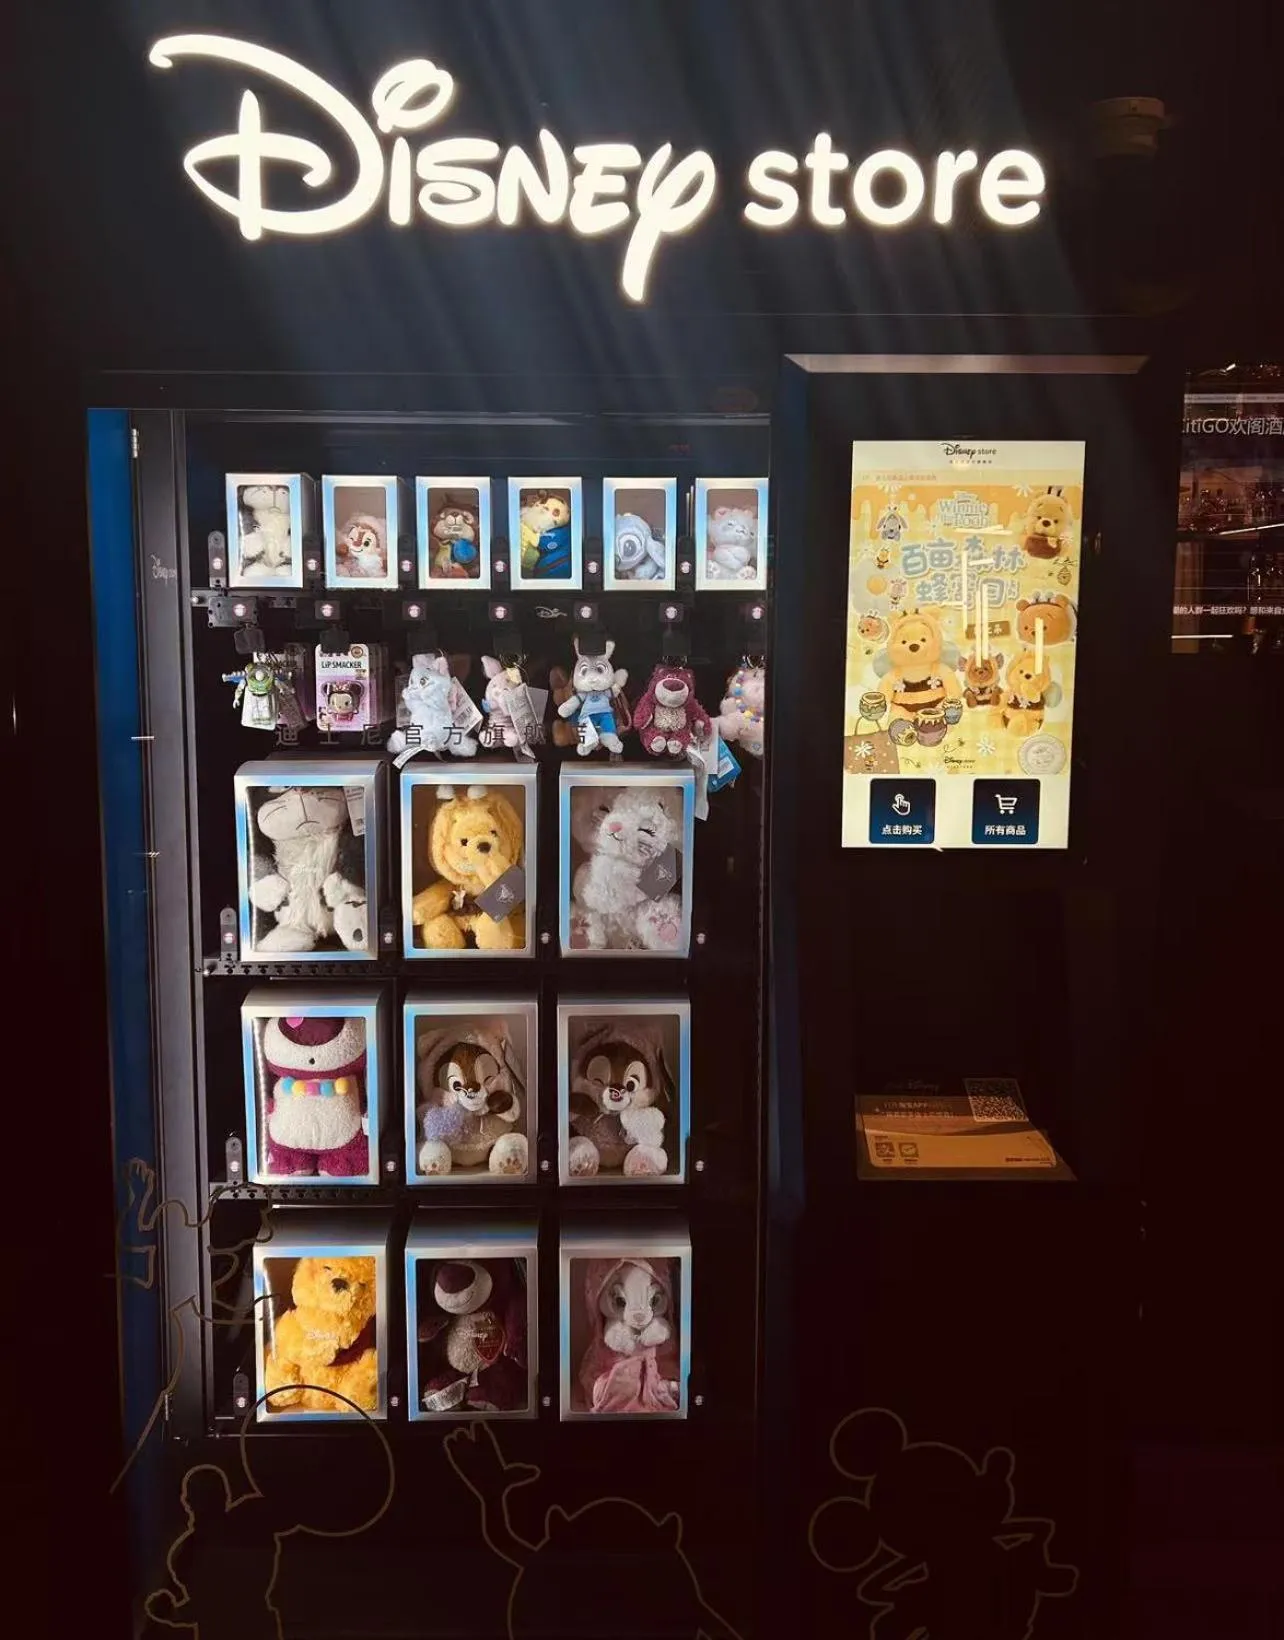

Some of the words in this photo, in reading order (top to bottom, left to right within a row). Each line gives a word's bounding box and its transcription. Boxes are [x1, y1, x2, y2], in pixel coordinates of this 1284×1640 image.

[149, 34, 717, 301] Disney
[744, 131, 1046, 228] store
[1182, 417, 1284, 436] itiGO欢阁酒
[940, 442, 976, 459] Disney
[977, 448, 997, 456] store
[881, 824, 923, 835] 点击购买
[984, 825, 1027, 835] 所有商品
